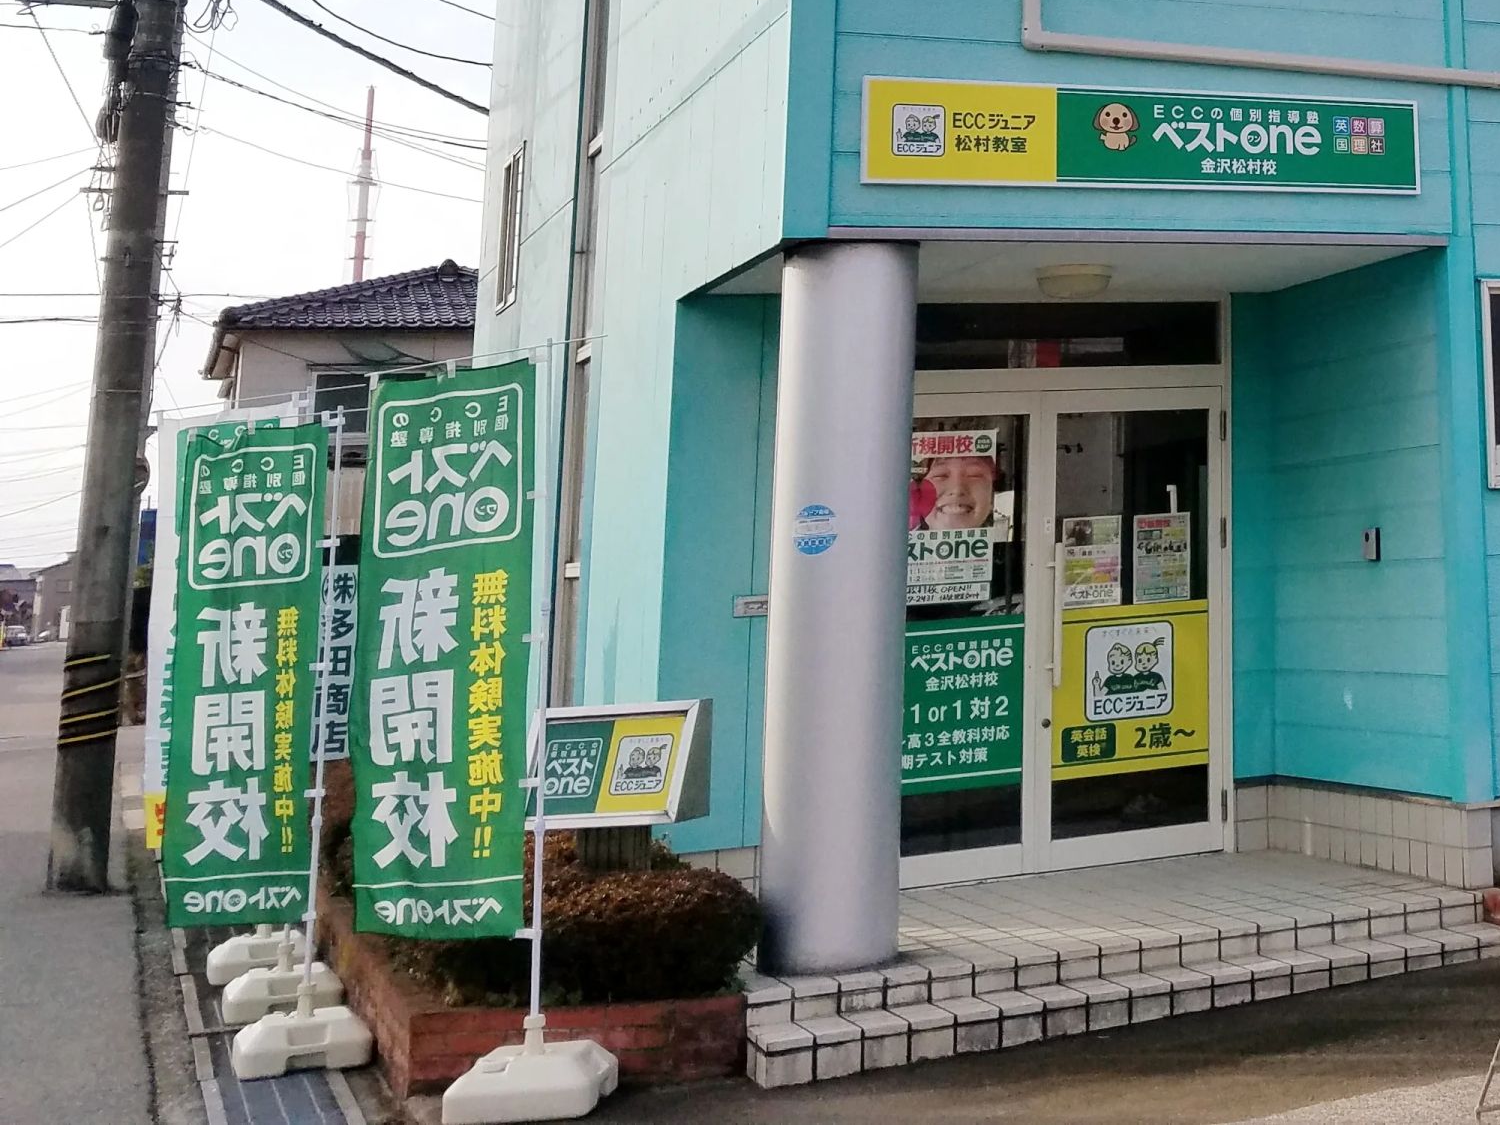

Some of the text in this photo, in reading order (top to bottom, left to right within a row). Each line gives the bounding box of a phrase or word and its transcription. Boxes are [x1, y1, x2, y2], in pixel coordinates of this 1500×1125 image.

[952, 112, 1036, 131] ECCジュニア
[1153, 104, 1320, 124] ECCの個別指導塾
[955, 134, 1028, 153] 松村教室
[1152, 121, 1322, 156] ベストone
[897, 143, 942, 154] ECCジュニア
[1200, 158, 1277, 175] 金沢松村校
[910, 646, 1014, 673] ベストone
[925, 671, 999, 692] 金沢松村校
[928, 705, 948, 722] or
[1093, 693, 1168, 716] ECCジュニア
[1070, 727, 1108, 743] 英会話
[546, 757, 594, 776] ベスト
[544, 775, 591, 795] one
[614, 779, 662, 792] ECCジュニア
